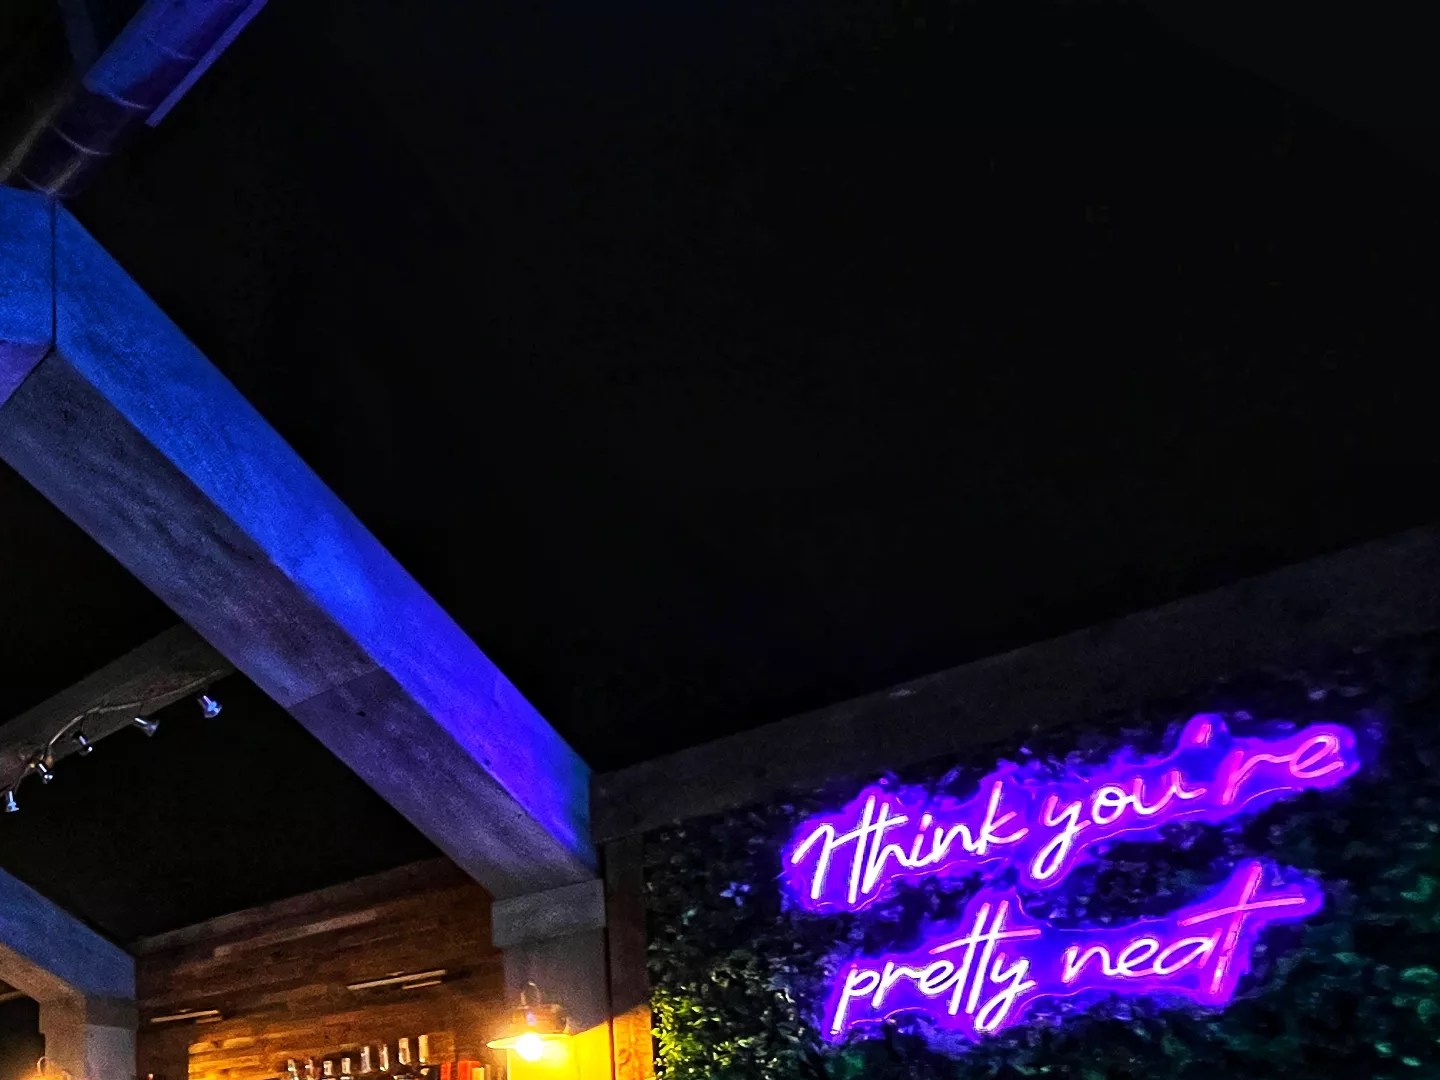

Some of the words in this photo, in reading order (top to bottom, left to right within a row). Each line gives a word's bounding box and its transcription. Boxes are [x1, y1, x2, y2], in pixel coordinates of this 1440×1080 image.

[1030, 723, 1345, 880] you're
[830, 900, 1043, 1035] pretty
[1063, 862, 1307, 995] neat
